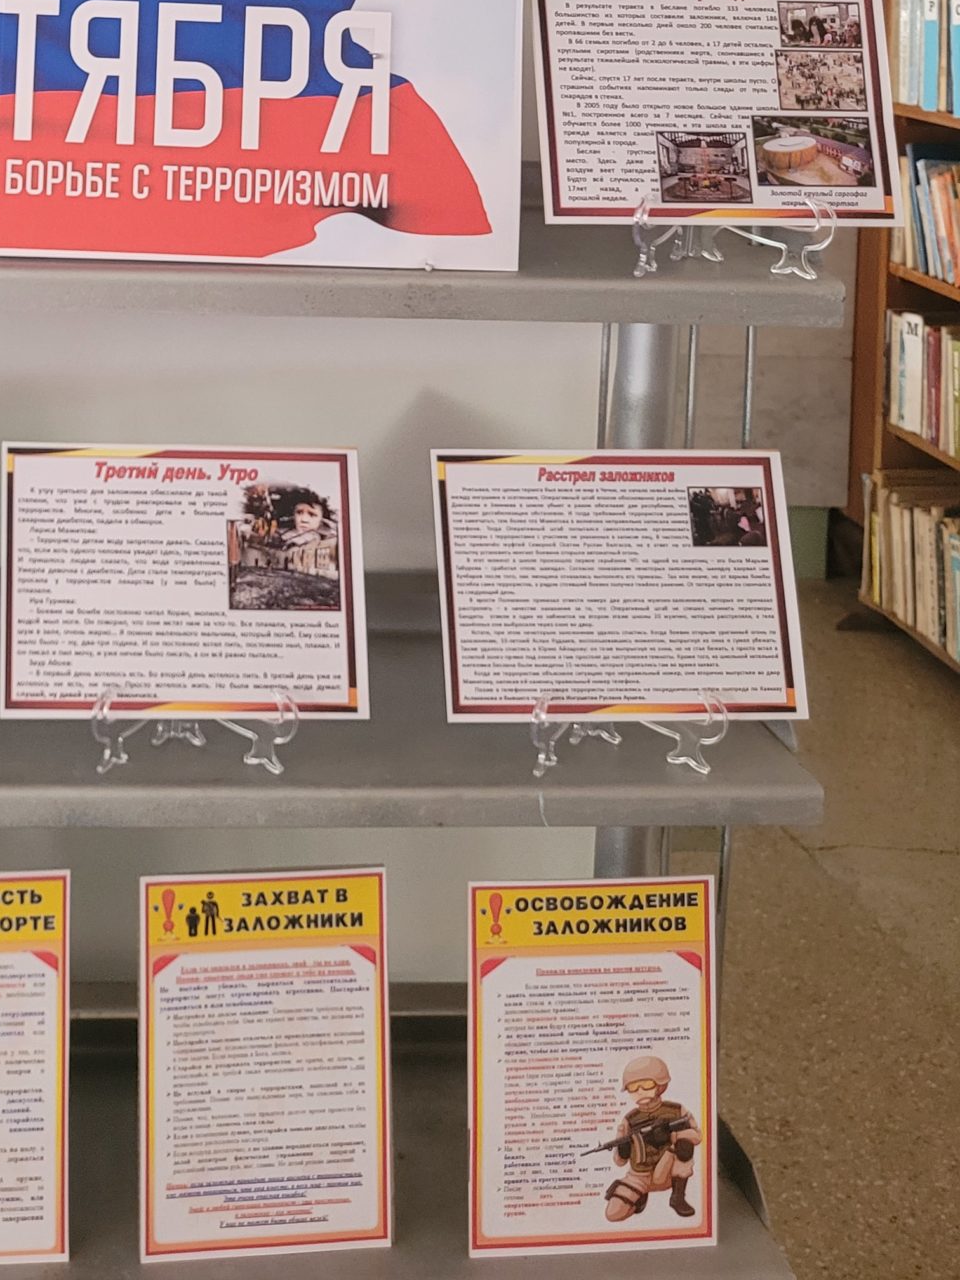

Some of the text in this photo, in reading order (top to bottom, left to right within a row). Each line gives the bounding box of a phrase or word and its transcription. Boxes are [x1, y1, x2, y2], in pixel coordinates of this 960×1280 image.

[5, 159, 120, 198] БОРЬБЕ
[132, 164, 149, 199] С
[162, 165, 388, 209] ТЕРРОРИЗМОМ
[95, 460, 258, 484] Третий день. Утро
[538, 464, 675, 484] Расстрел заложников
[241, 888, 348, 907] ЗАХВАТ В
[515, 892, 698, 912] ОСВОБОЖДЕНИЕ
[224, 912, 363, 932] ЗАЛОЖНИКИ
[533, 916, 686, 935] ЗАЛОЖНИКОВ
